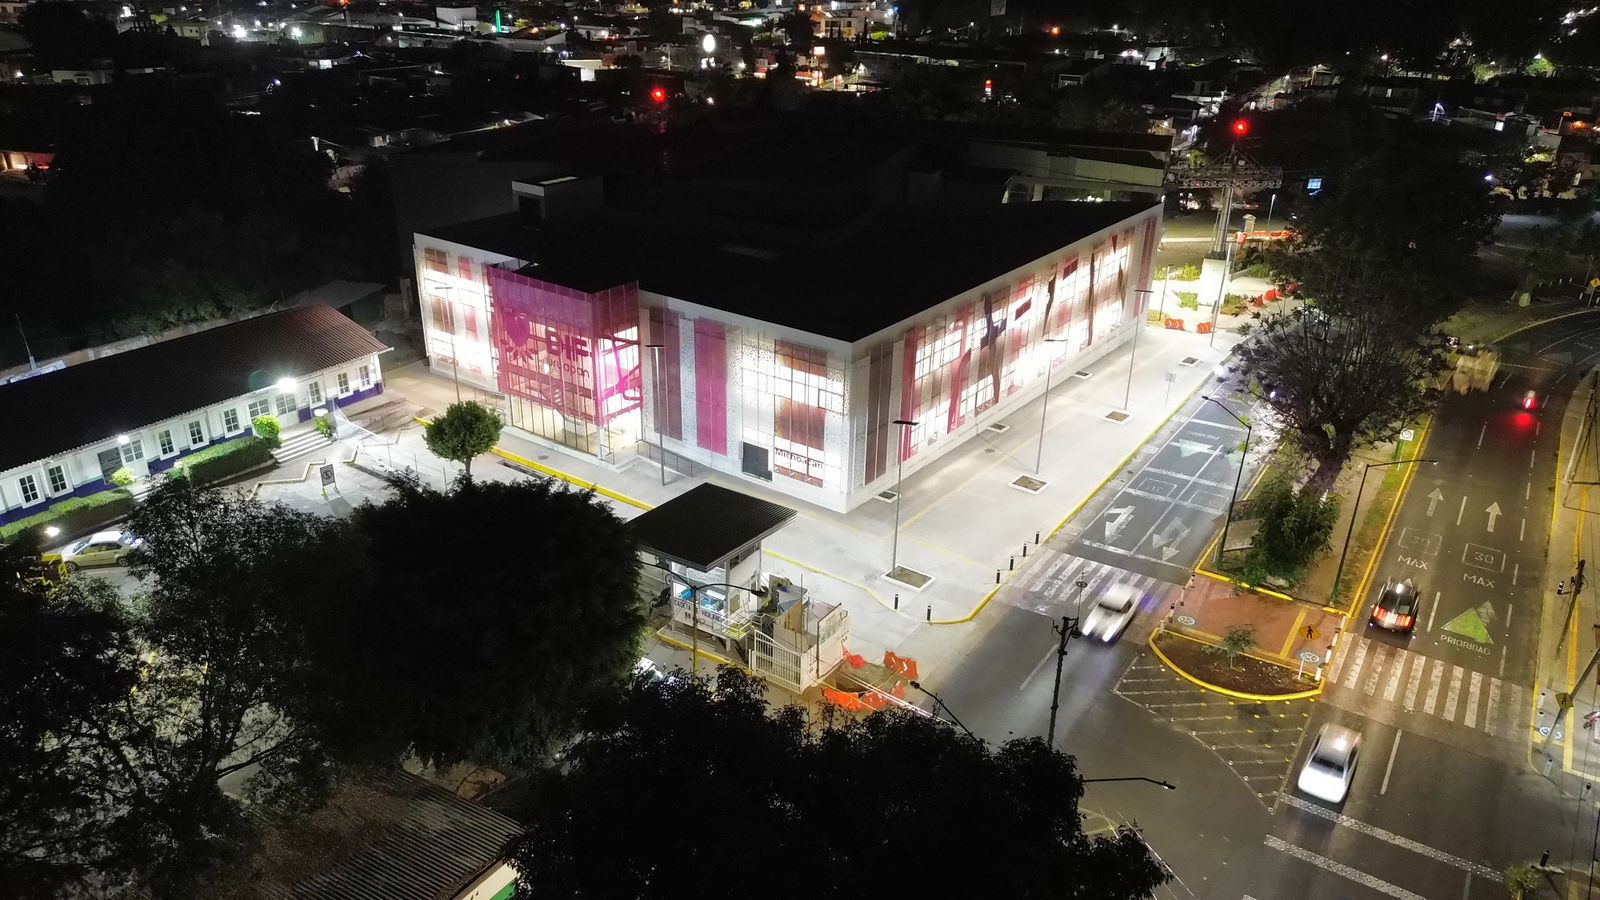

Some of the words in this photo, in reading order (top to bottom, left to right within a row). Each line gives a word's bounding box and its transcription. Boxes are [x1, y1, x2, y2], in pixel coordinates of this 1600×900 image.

[1397, 554, 1428, 570] MAX
[1474, 551, 1495, 564] 30
[1463, 573, 1495, 589] MAX
[1440, 634, 1491, 656] PRIORIDAD
